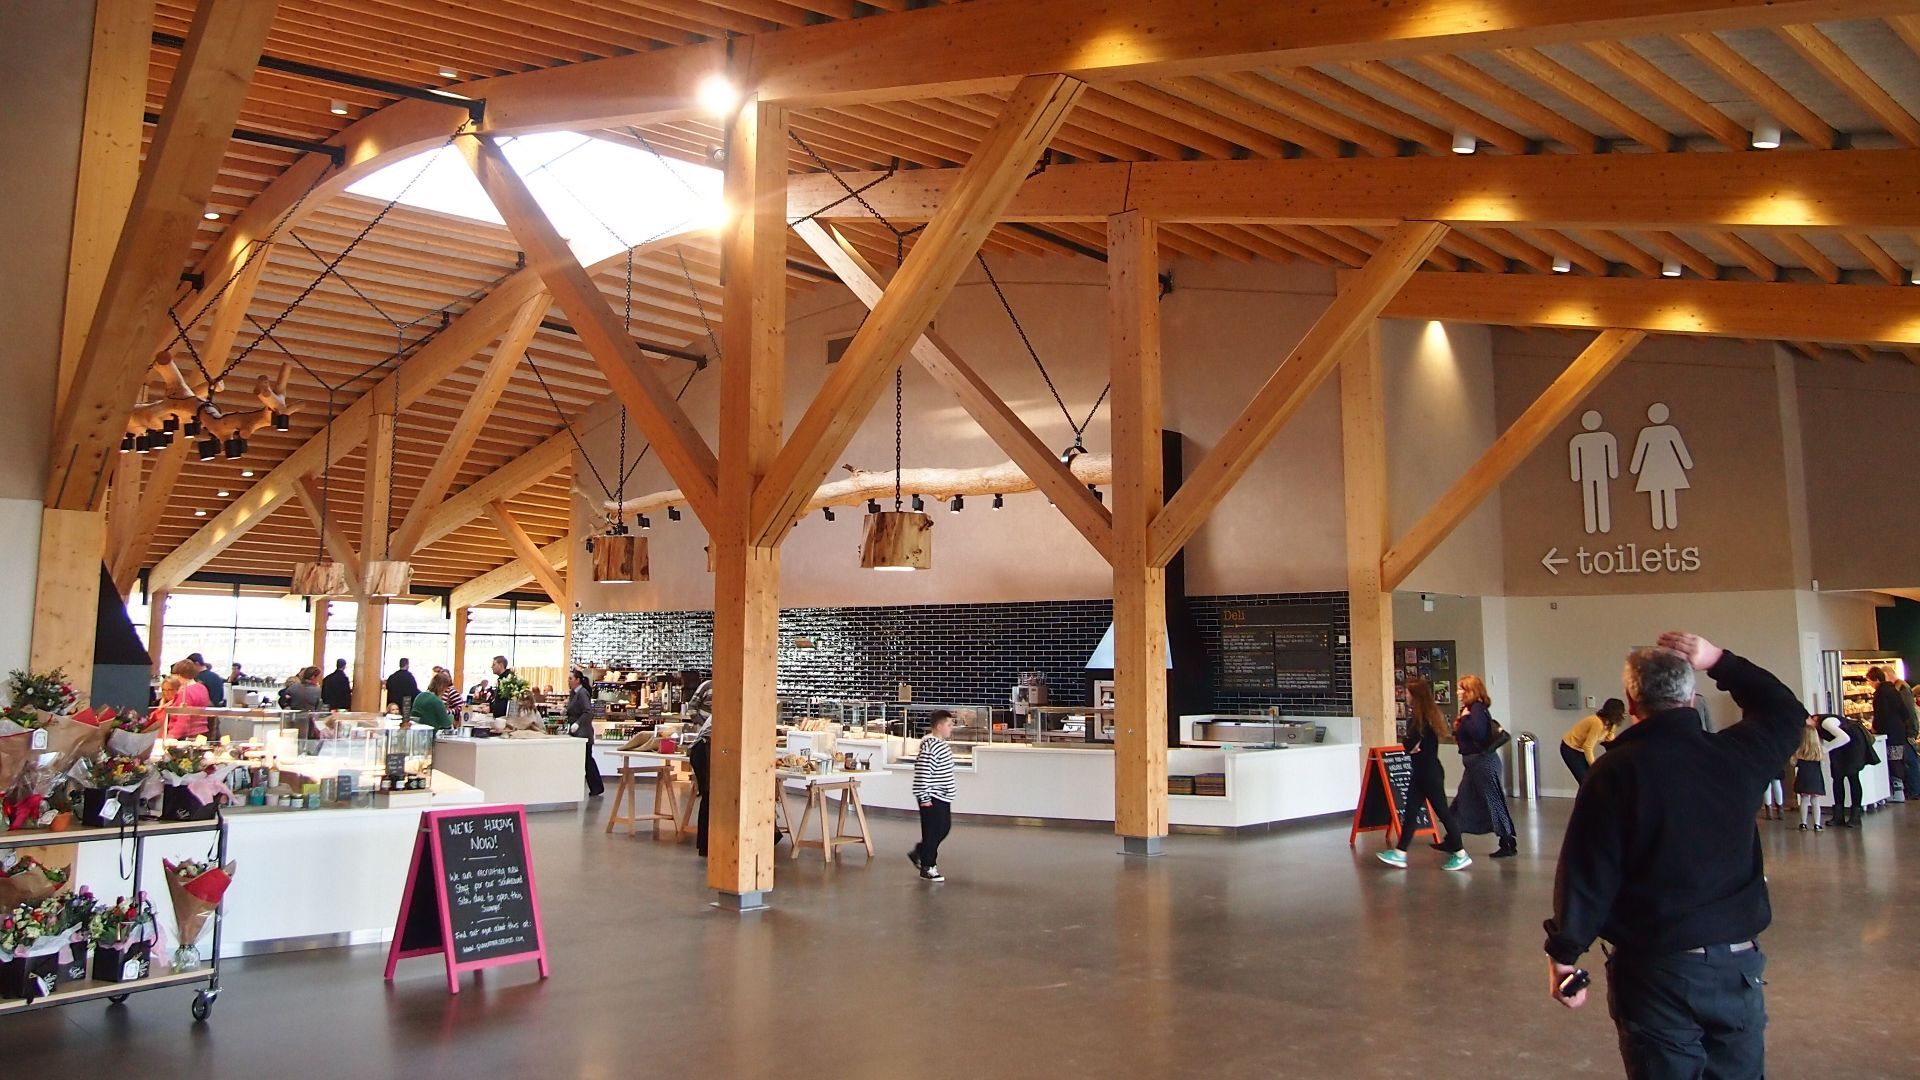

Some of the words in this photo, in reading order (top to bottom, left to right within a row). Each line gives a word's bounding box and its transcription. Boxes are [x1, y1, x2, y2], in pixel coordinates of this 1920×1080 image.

[1577, 542, 1701, 575] toilets
[1223, 610, 1245, 620] Deli
[449, 822, 474, 835] WE'RE
[485, 818, 514, 833] HIRING
[471, 834, 499, 850] NOW!
